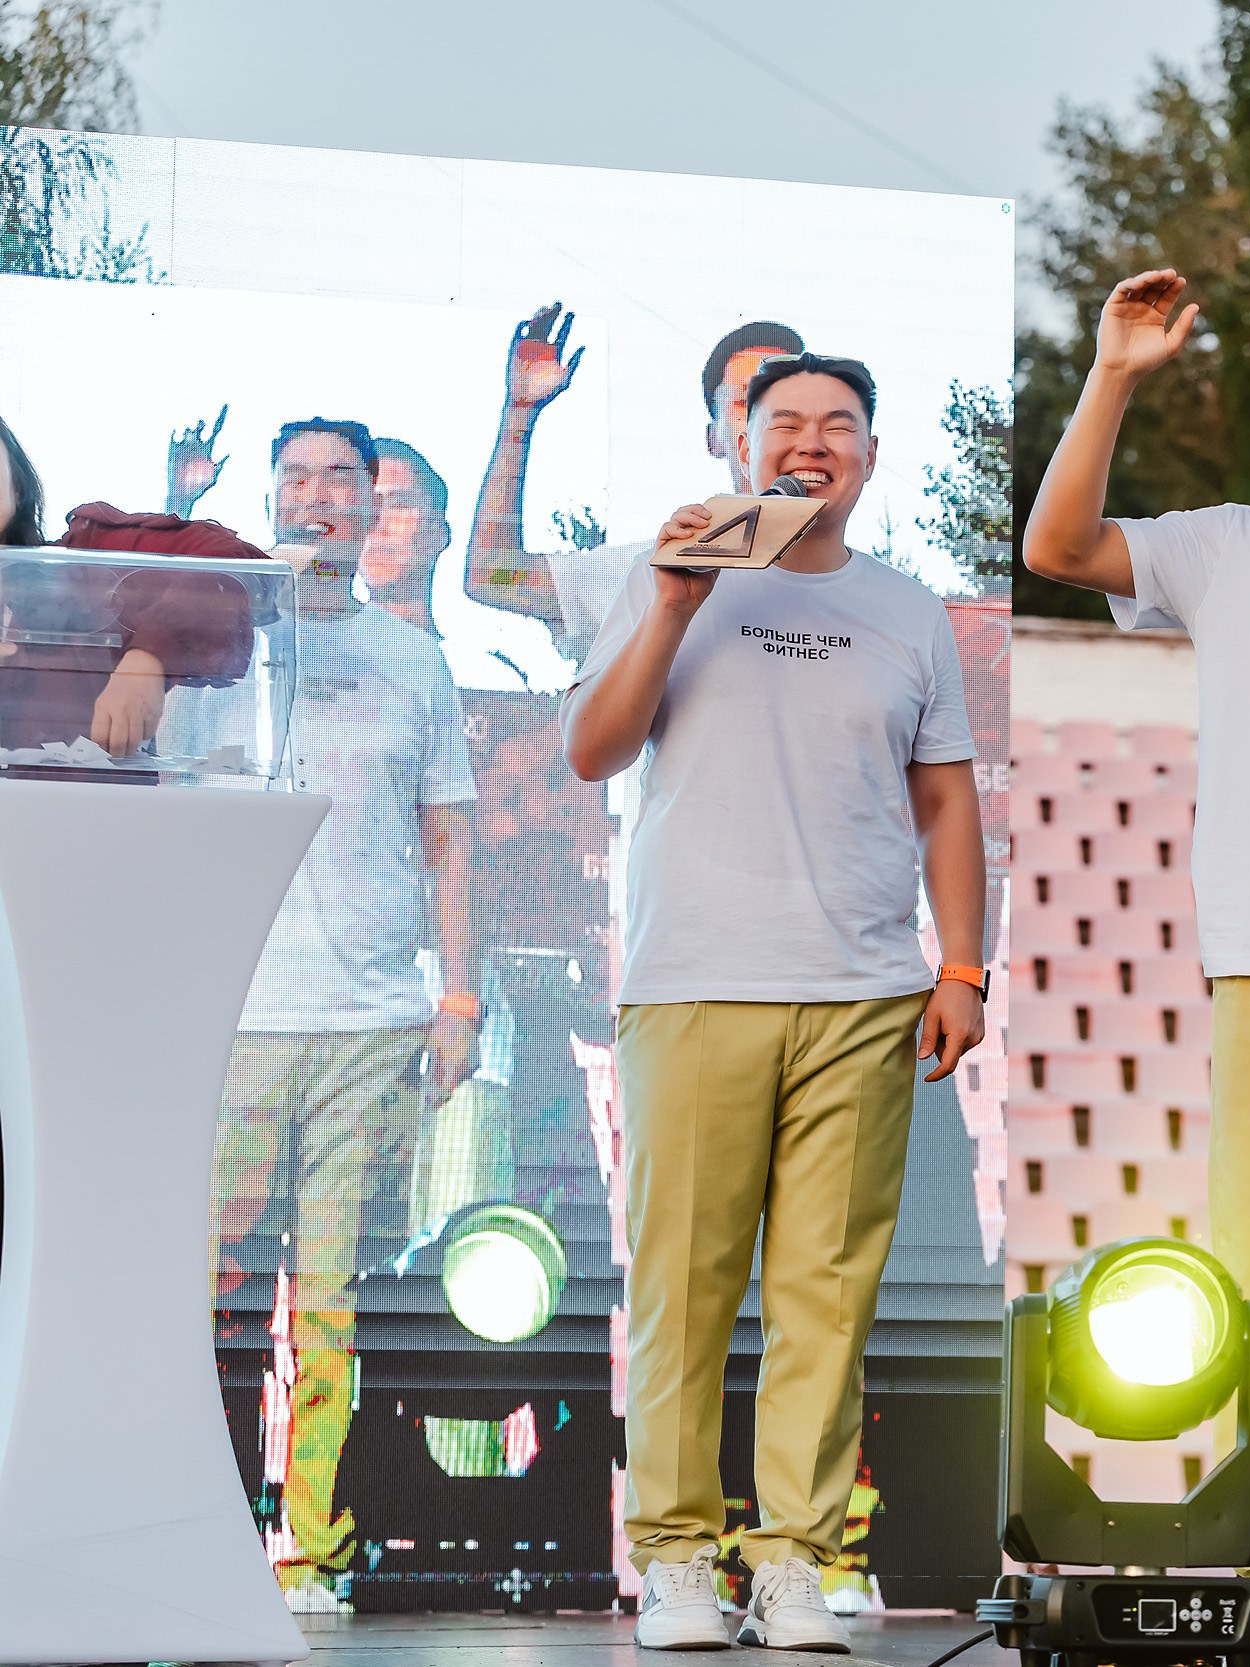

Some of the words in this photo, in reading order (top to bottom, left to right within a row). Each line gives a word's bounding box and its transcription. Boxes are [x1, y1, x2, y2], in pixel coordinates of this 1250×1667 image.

[741, 625, 812, 645] БОЛЬШЕ
[816, 634, 851, 648] ЧЕМ
[763, 642, 830, 660] ФИТНЕС
[1221, 1625, 1235, 1634] CE
